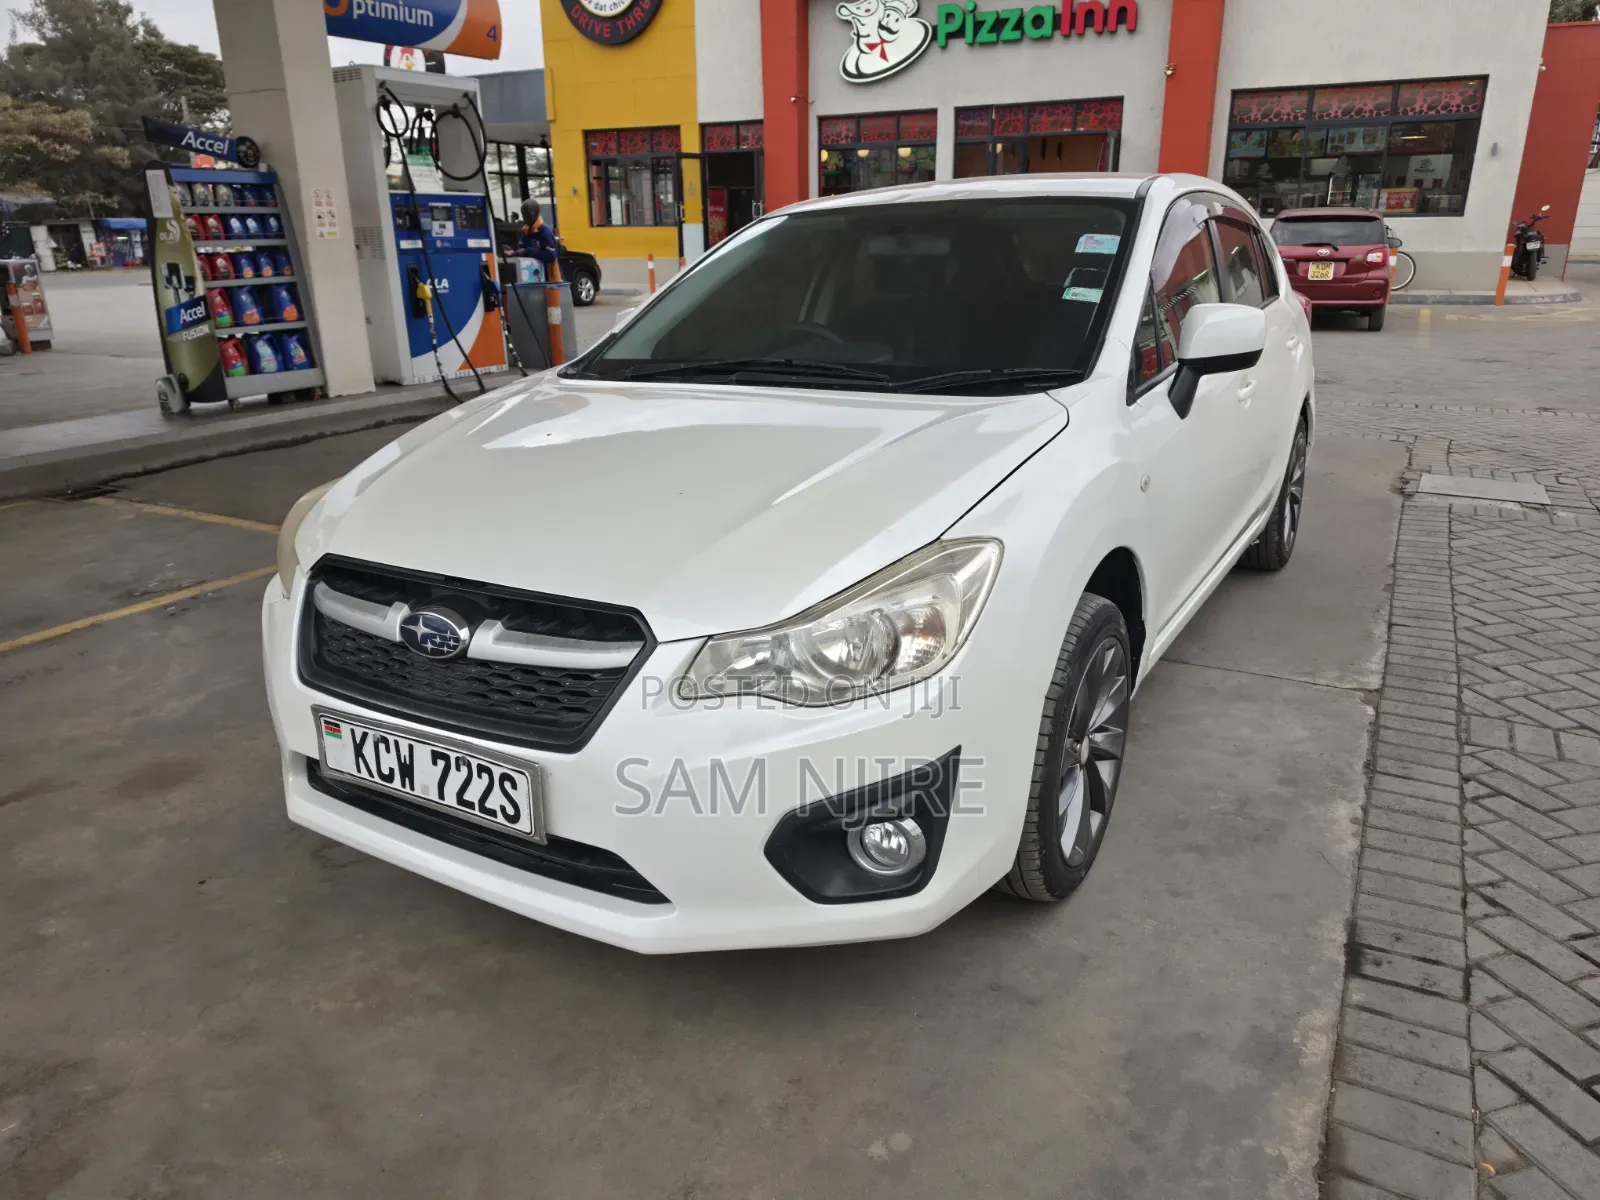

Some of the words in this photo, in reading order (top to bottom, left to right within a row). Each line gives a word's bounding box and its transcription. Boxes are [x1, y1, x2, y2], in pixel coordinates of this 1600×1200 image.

[609, 0, 627, 11] chic
[571, 5, 611, 38] DRIVE
[616, 0, 652, 34] THRU
[486, 24, 498, 42] 4
[181, 131, 229, 155] Accel
[180, 301, 206, 324] Accel
[350, 728, 415, 791] KCW
[430, 748, 521, 825] 722S
